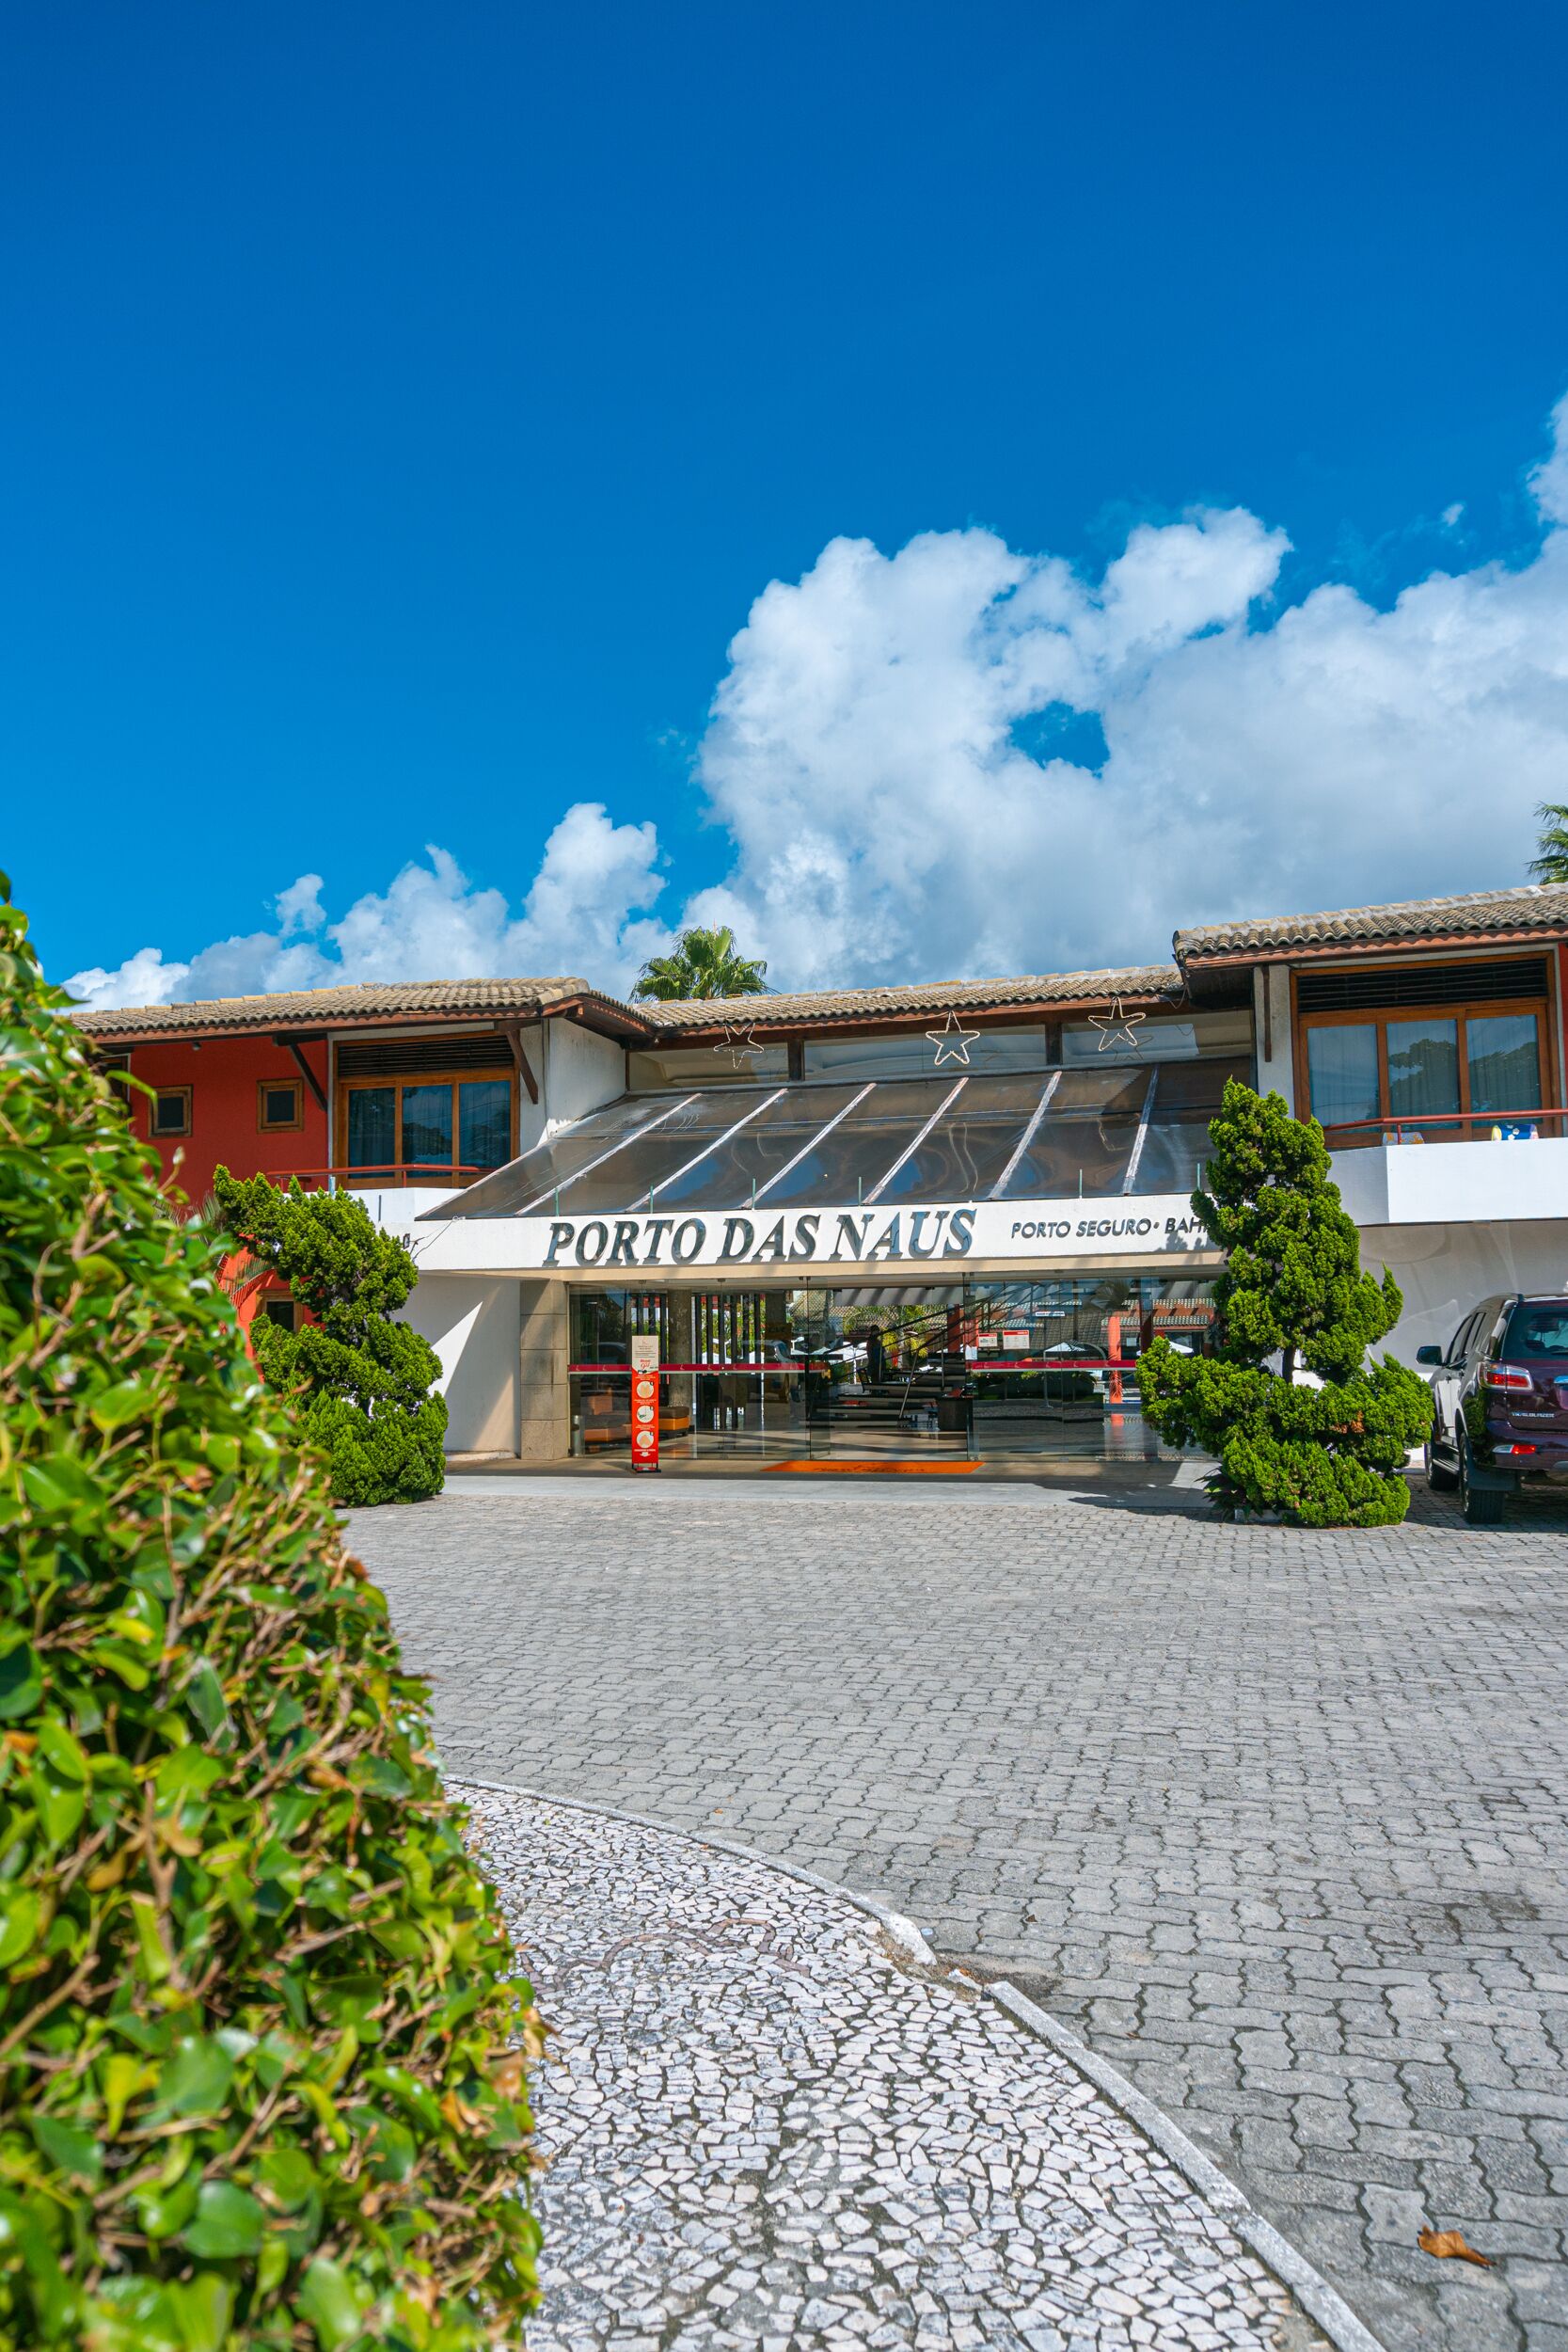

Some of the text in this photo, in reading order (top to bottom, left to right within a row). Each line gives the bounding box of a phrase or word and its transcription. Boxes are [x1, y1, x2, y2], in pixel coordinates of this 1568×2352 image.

[543, 1208, 977, 1263] PORTO DAS NAUS
[1011, 1217, 1208, 1238] PORTO SEGURO BAH
